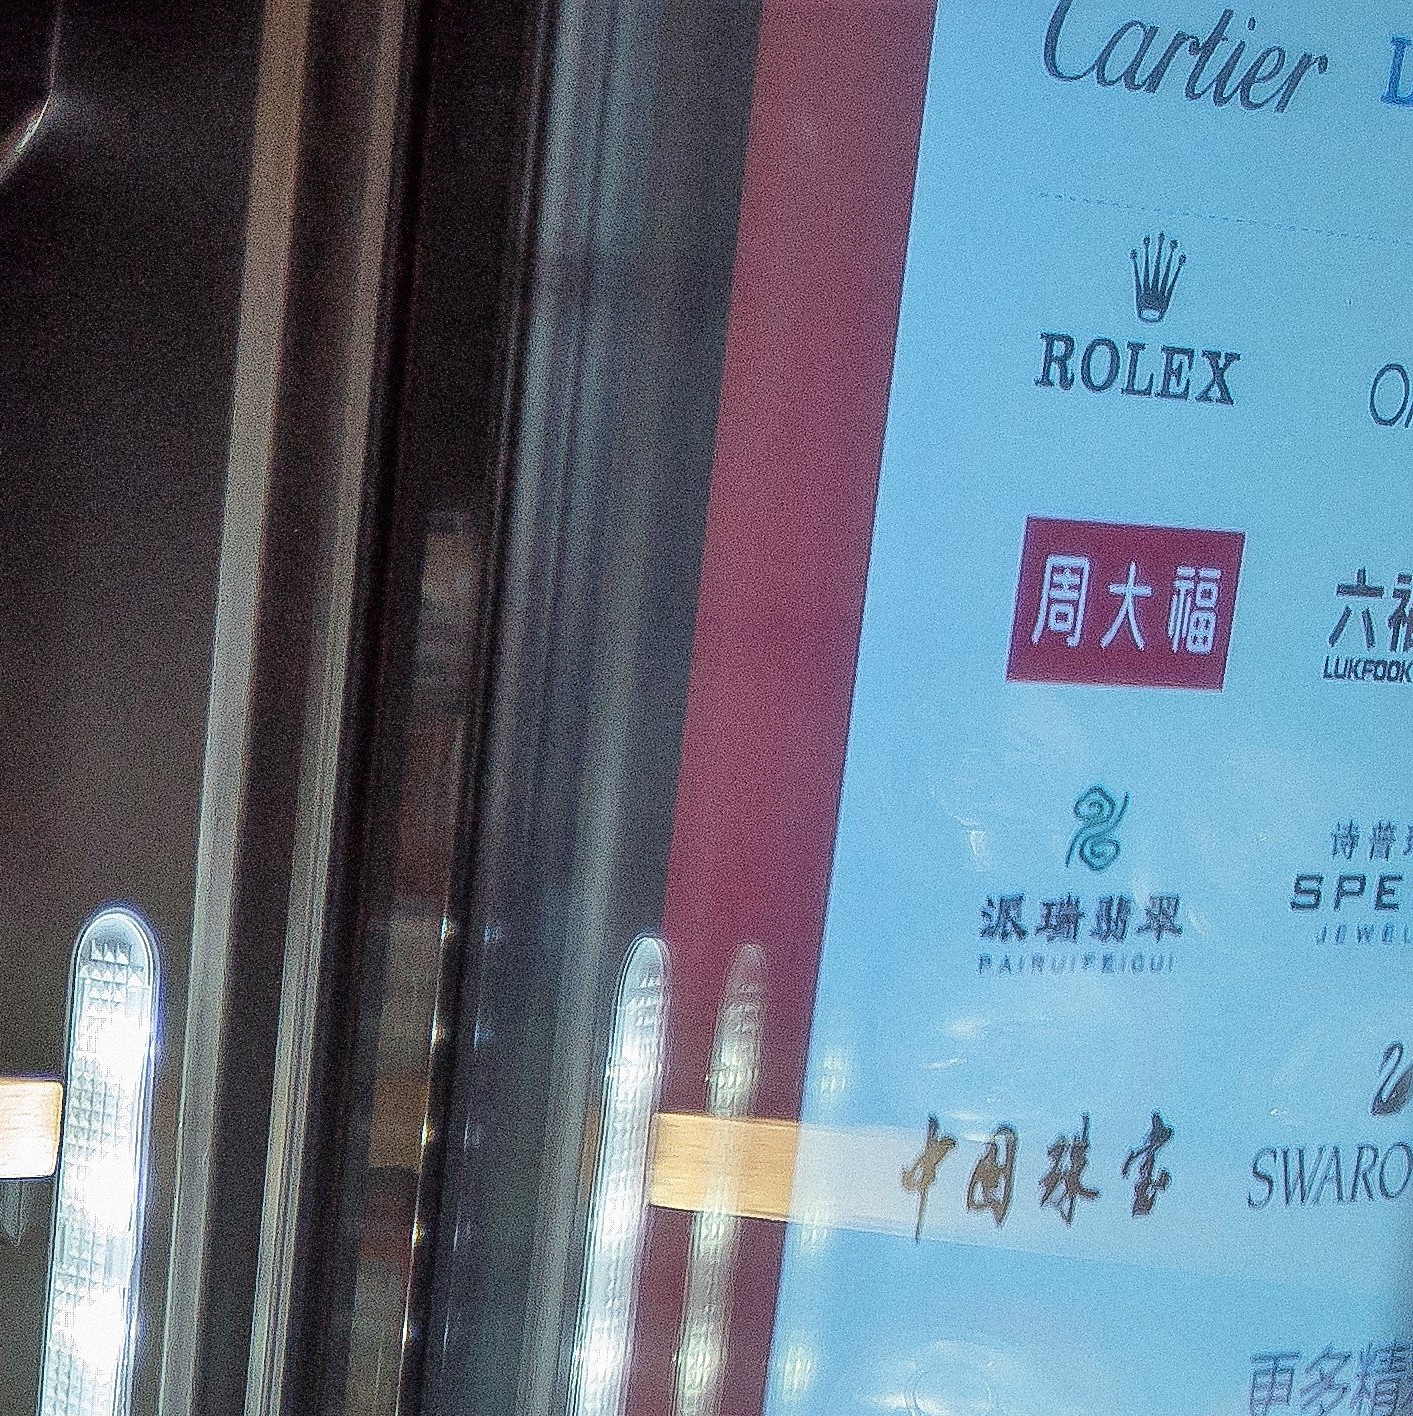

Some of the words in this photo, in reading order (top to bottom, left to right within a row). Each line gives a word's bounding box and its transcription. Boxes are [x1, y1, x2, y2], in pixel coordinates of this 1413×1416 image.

[1044, 0, 1328, 113] Cartier
[1035, 332, 1240, 406] ROLEX
[1369, 362, 1413, 428] O
[1031, 553, 1222, 655] 周大福
[1246, 1142, 1413, 1210] SWARO
